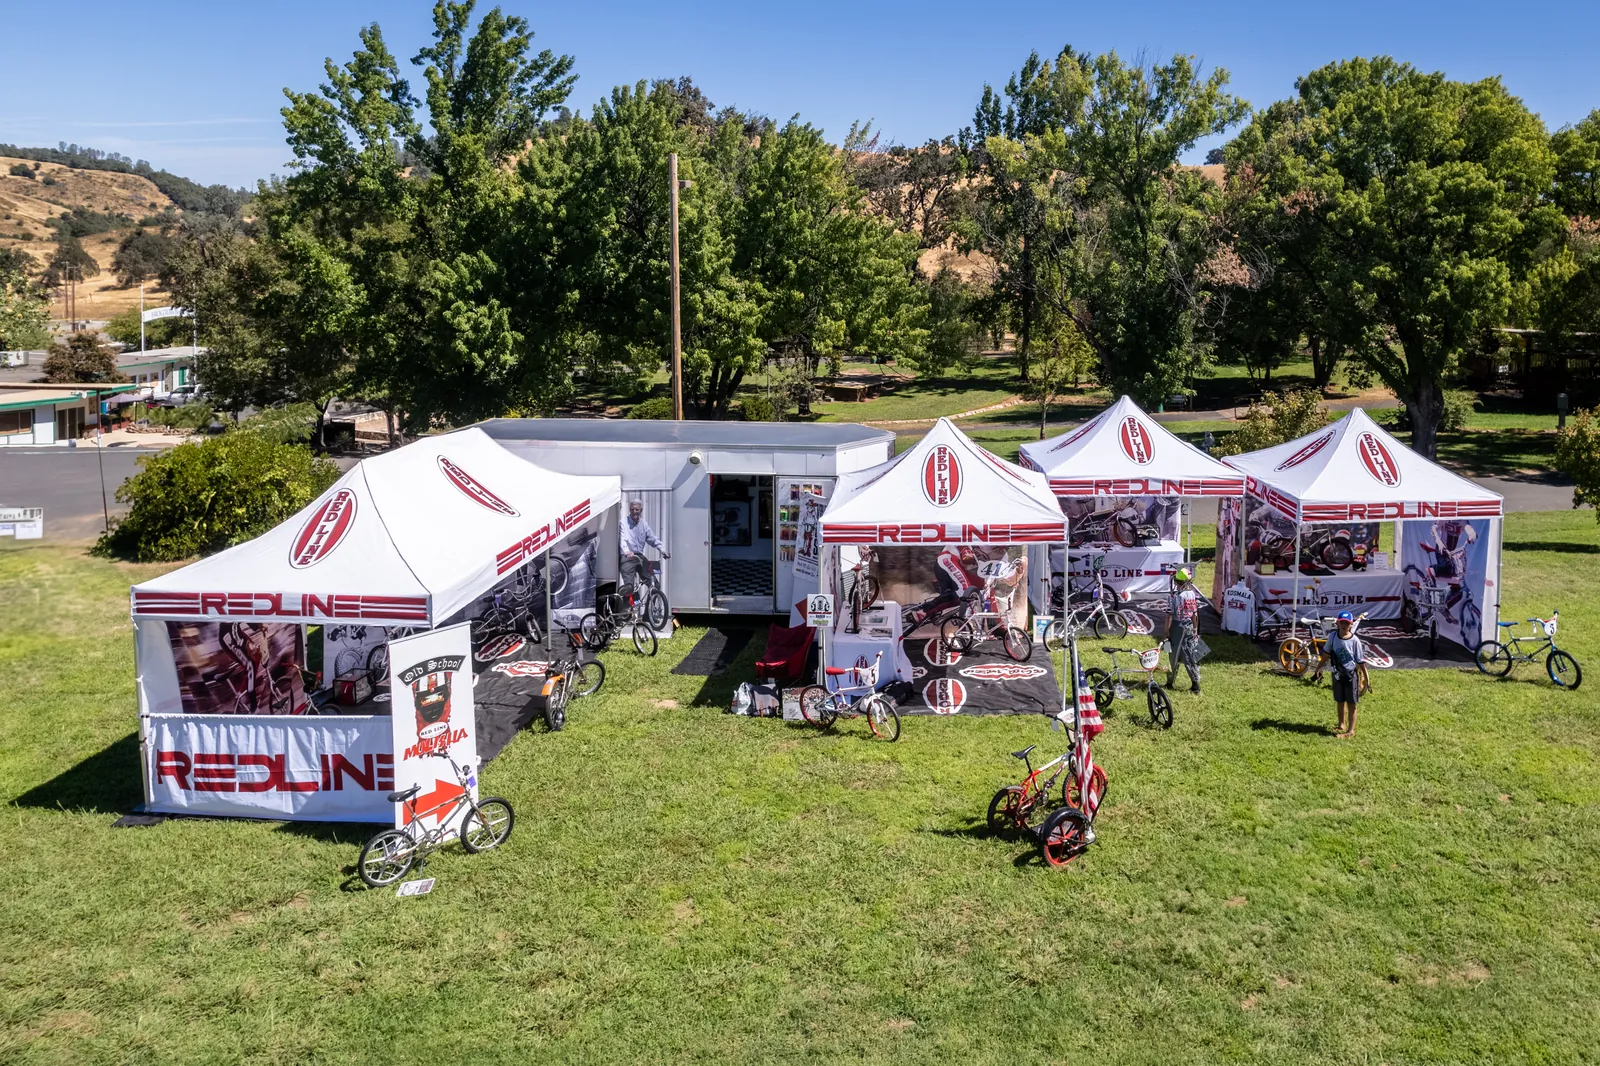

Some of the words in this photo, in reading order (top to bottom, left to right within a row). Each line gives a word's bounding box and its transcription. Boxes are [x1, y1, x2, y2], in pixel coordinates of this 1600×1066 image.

[1127, 417, 1139, 438] RED
[937, 446, 948, 472] RED
[1132, 438, 1146, 463] LINE
[1363, 433, 1379, 456] RED
[1373, 457, 1396, 485] LINE
[937, 473, 948, 505] LINE
[1094, 479, 1200, 495] REDLINE
[323, 491, 350, 522] RED
[1349, 501, 1457, 520] REDLINE
[296, 525, 329, 565] LINE
[521, 508, 574, 560] REDLINE
[878, 523, 1010, 543] REDLINE
[1114, 569, 1143, 578] LINE
[200, 592, 361, 618] REDLINE
[1227, 590, 1252, 600] KOSMALA
[1334, 595, 1364, 605] LINE
[404, 666, 424, 683] Old
[427, 658, 462, 672] School
[420, 728, 433, 736] RED
[434, 724, 448, 732] LINE
